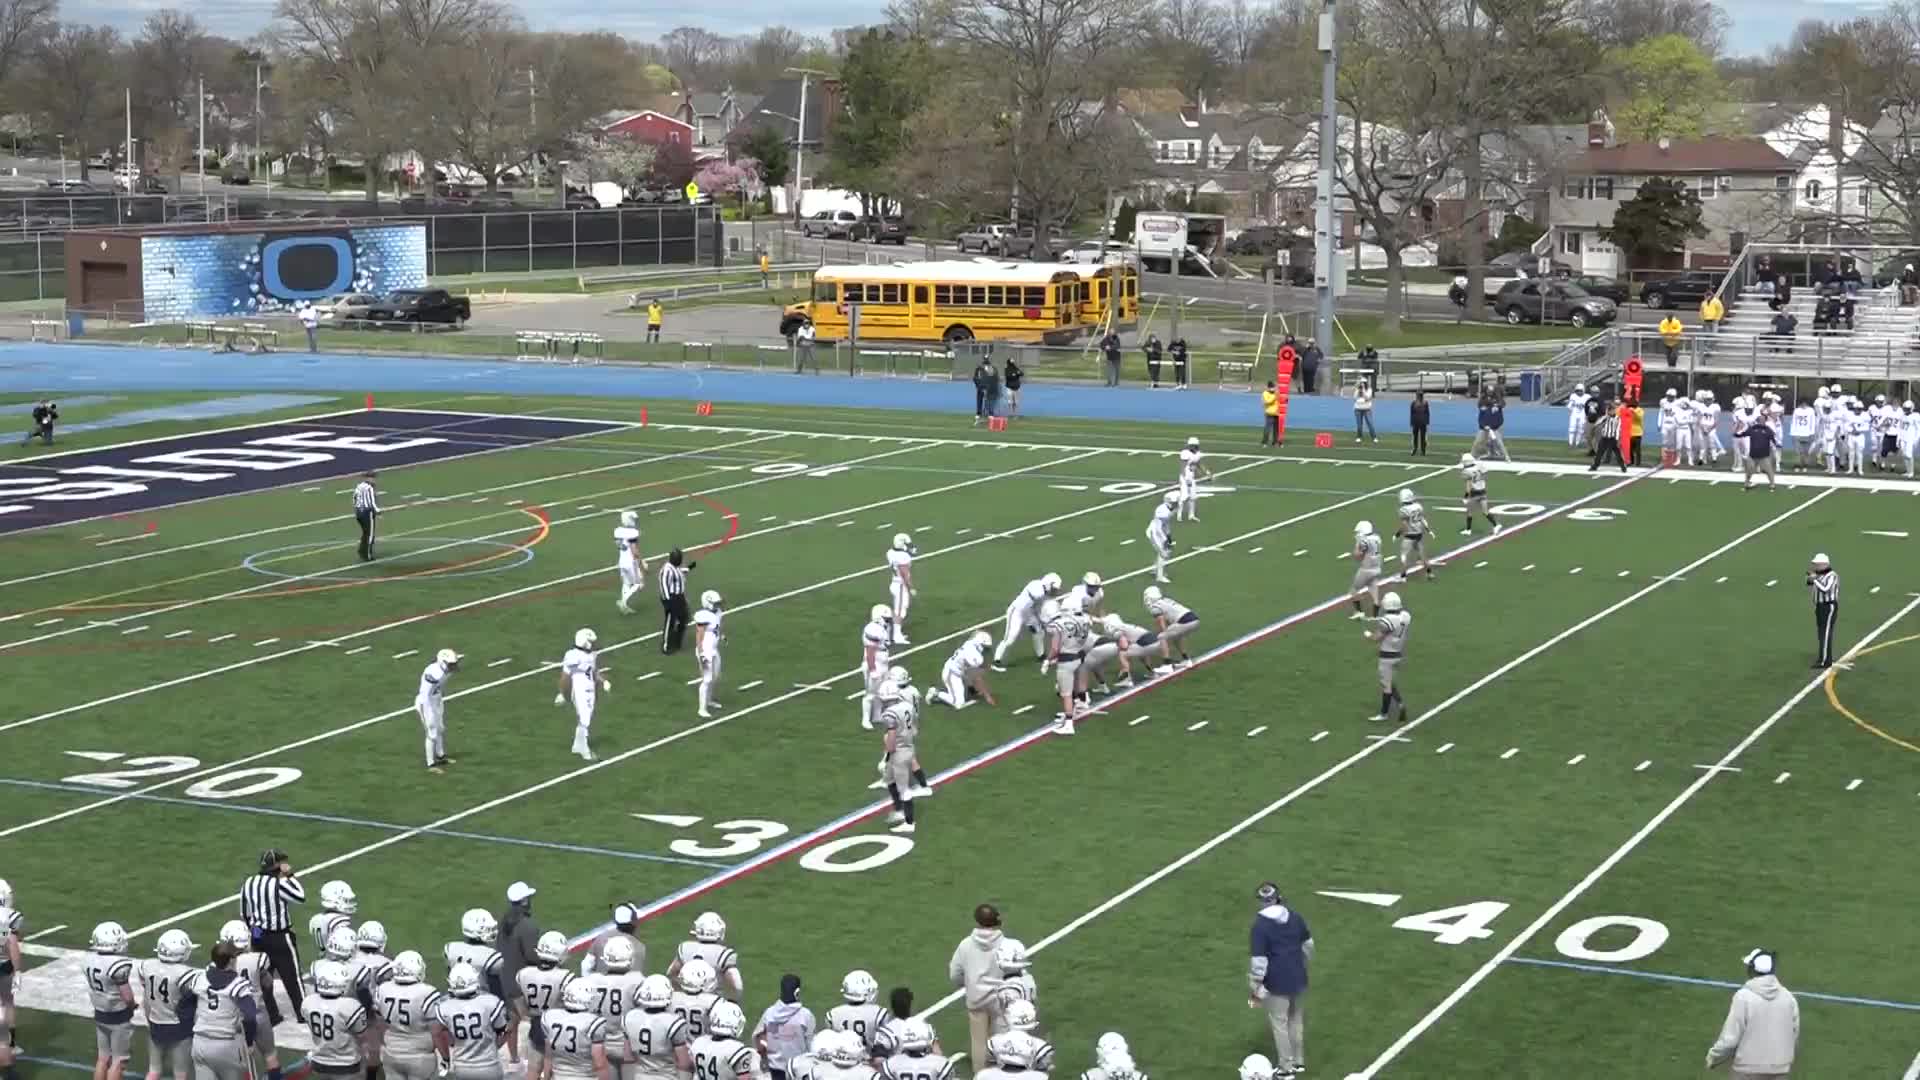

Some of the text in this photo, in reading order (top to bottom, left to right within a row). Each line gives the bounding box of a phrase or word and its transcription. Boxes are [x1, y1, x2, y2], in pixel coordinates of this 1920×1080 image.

[0, 431, 448, 515] SIDE
[86, 966, 104, 992] 15
[149, 975, 170, 1004] 14
[206, 989, 219, 1011] 5
[526, 983, 553, 1010] 27
[597, 987, 623, 1016] 78
[309, 1011, 335, 1041] 68
[384, 997, 411, 1026] 75
[452, 1012, 483, 1041] 62
[551, 1023, 577, 1053] 73
[638, 1028, 651, 1056] 9
[695, 1053, 719, 1080] 64
